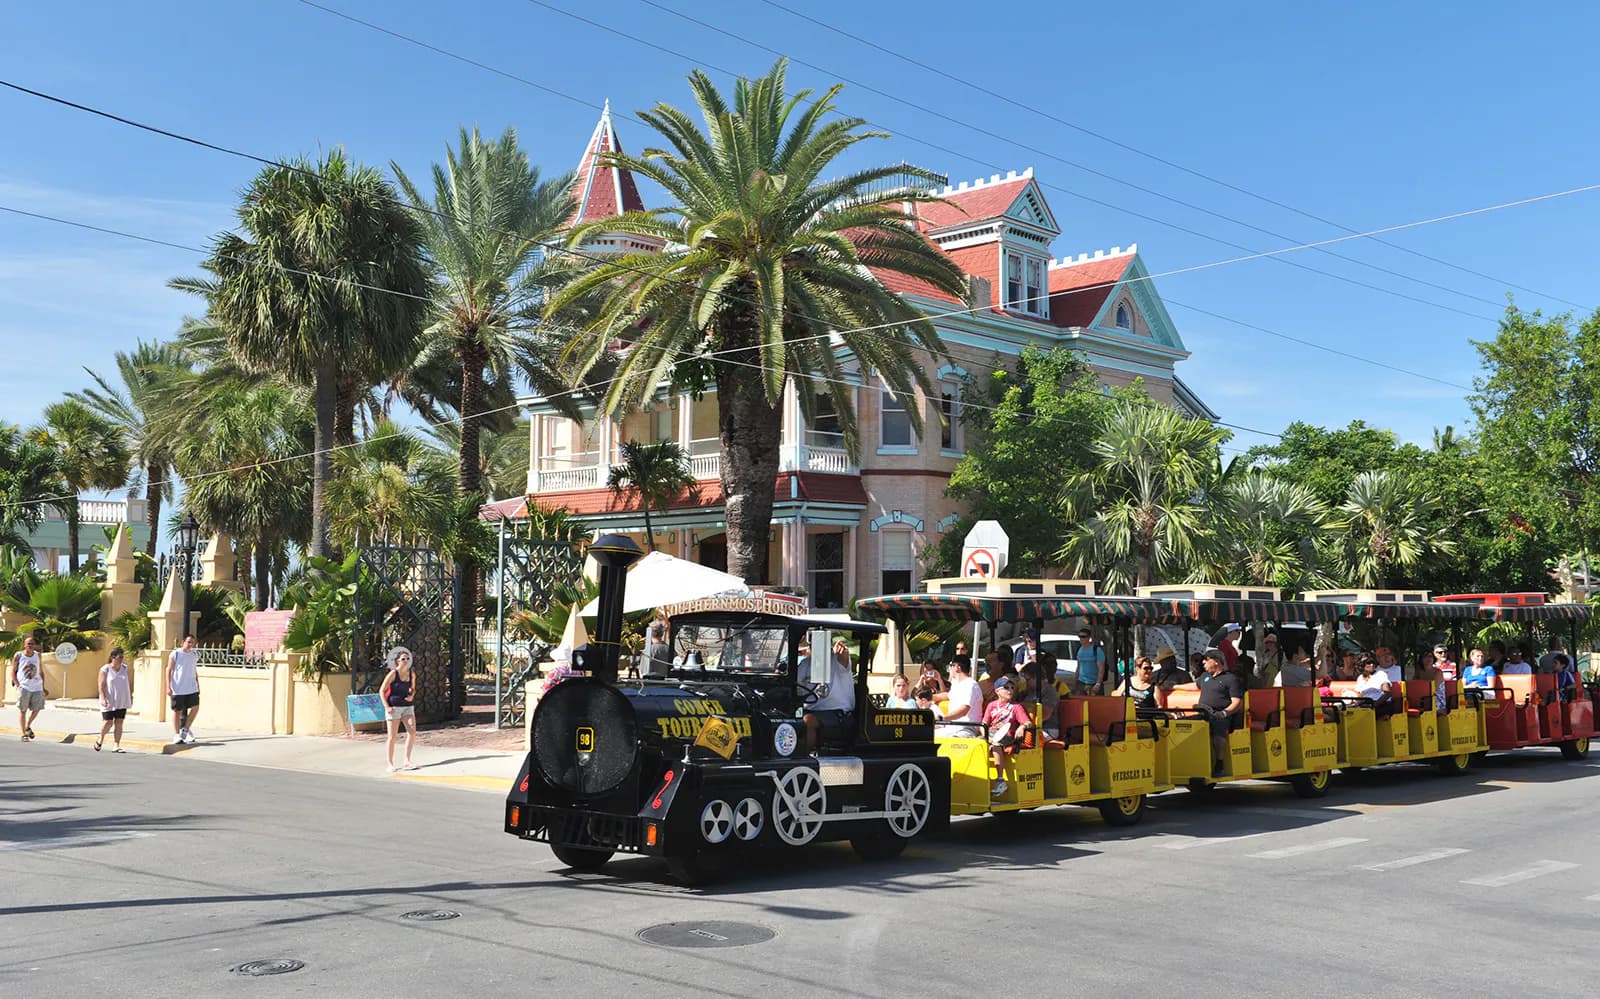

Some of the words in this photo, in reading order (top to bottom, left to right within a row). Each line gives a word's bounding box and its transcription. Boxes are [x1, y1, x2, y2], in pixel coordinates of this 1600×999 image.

[674, 699, 727, 716] CONCH
[874, 714, 910, 726] OVERSEAS
[894, 727, 903, 738] 98
[580, 733, 590, 745] 98
